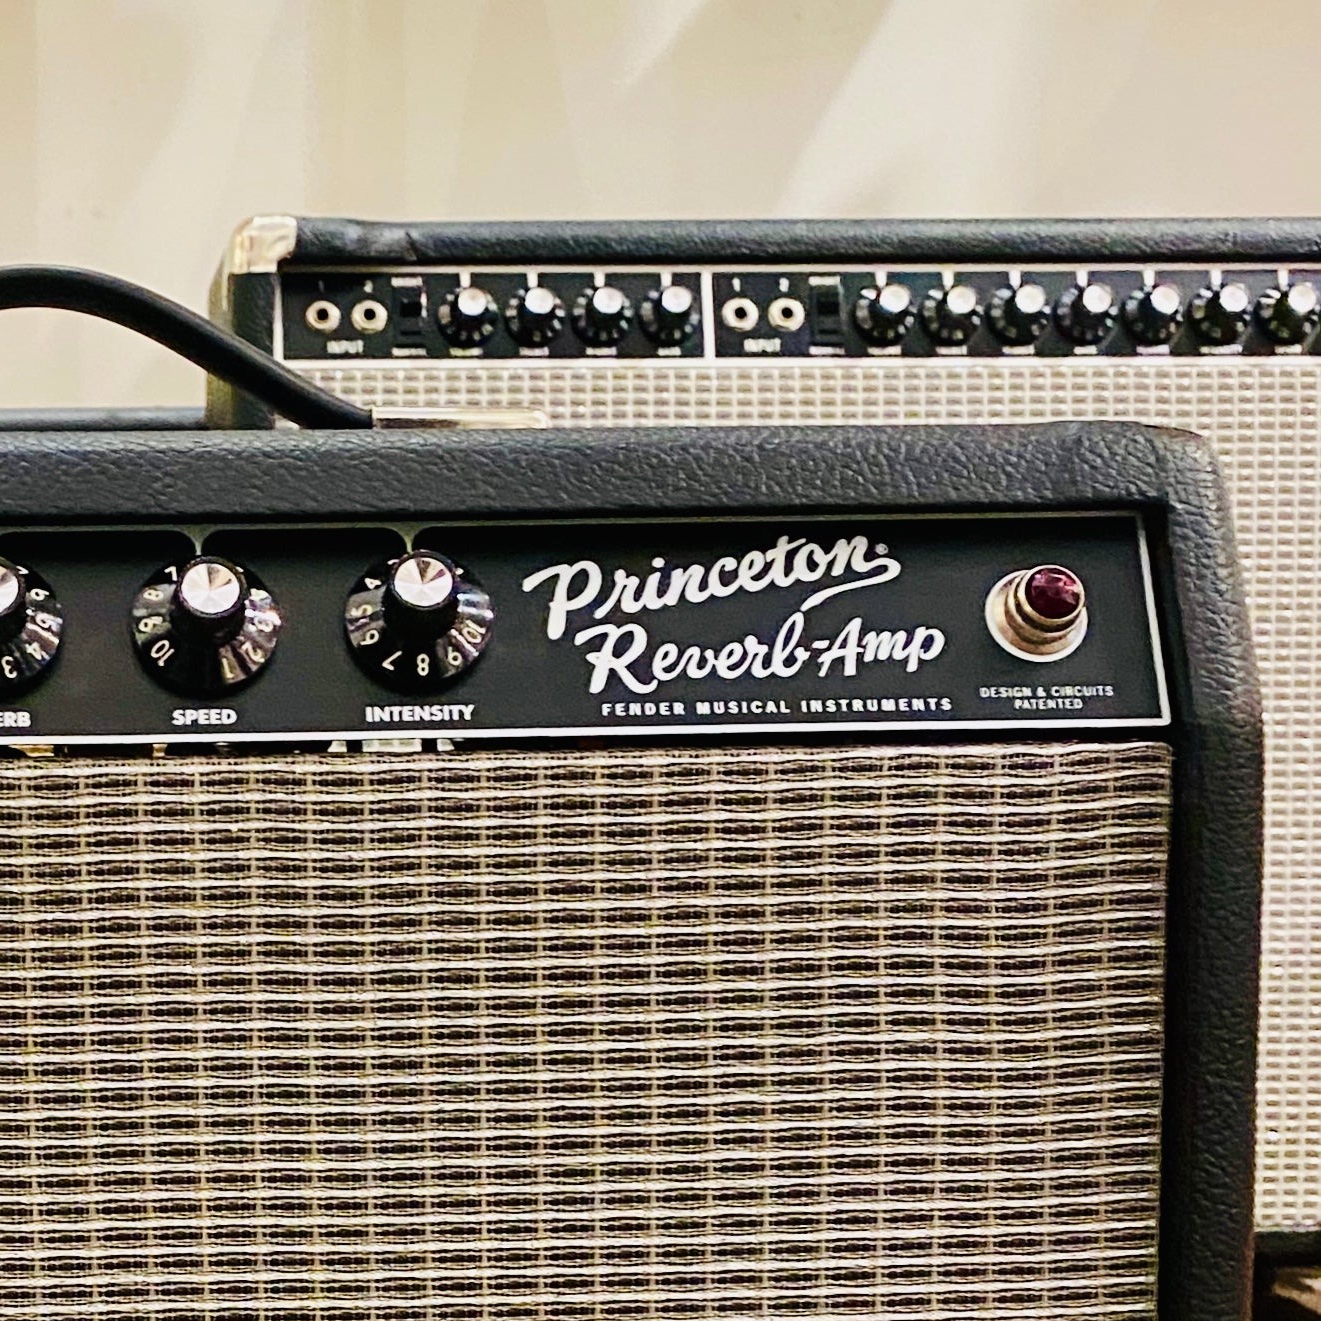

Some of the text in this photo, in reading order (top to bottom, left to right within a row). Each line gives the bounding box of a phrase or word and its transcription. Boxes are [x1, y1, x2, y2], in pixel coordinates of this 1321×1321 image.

[164, 566, 178, 581] 7
[522, 535, 902, 640] Princeton
[364, 577, 382, 589] 4
[381, 651, 403, 671] 7
[416, 653, 429, 676] 8
[461, 619, 486, 643] 10
[150, 640, 175, 666] 10
[241, 641, 265, 663] 2
[574, 611, 945, 694] Reverb-Amp
[1, 656, 18, 678] 3
[979, 685, 1114, 698] DESIGN & CIRCUITS
[365, 704, 475, 723] INTENSITY
[601, 697, 952, 717] FENDER MUSICAL INSTRUMENTS
[1013, 698, 1084, 710] PATENTED
[171, 708, 238, 726] SPEED
